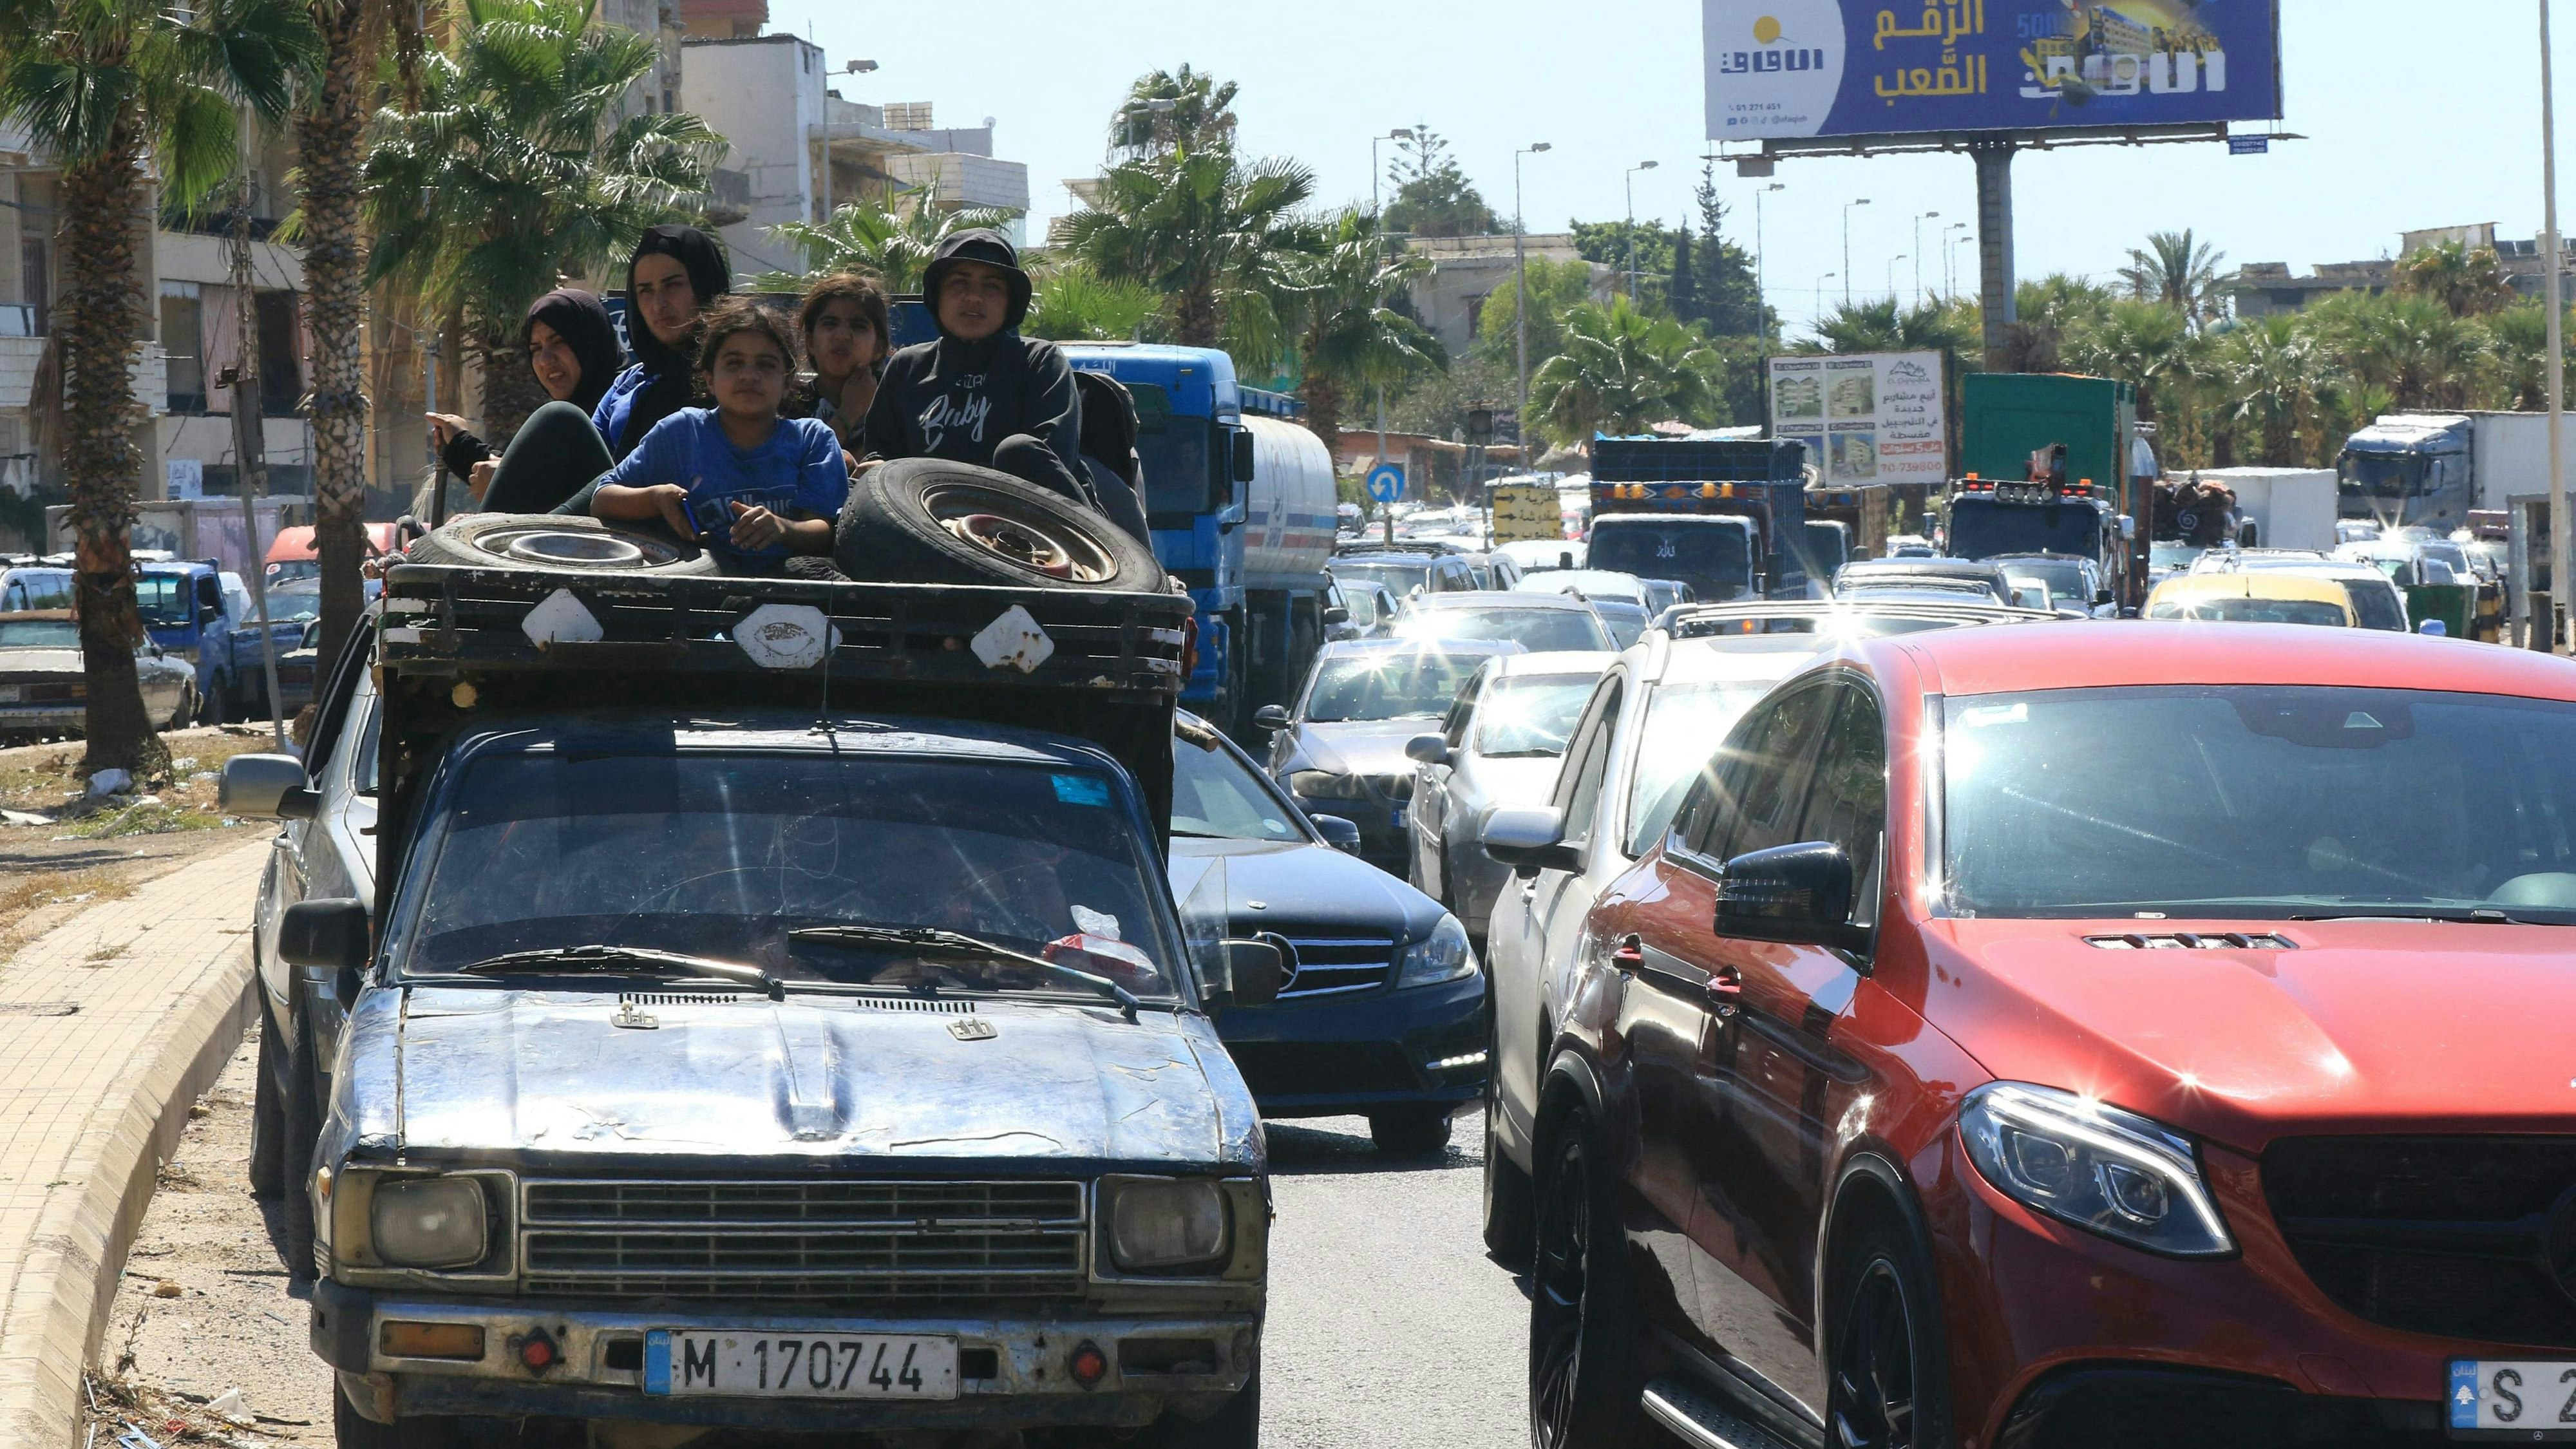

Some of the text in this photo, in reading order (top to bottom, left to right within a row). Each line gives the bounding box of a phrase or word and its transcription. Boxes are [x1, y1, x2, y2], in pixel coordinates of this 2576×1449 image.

[684, 1338, 923, 1392] M 170744
[2453, 1365, 2476, 1377] لبنان
[2493, 1368, 2523, 1422] S
